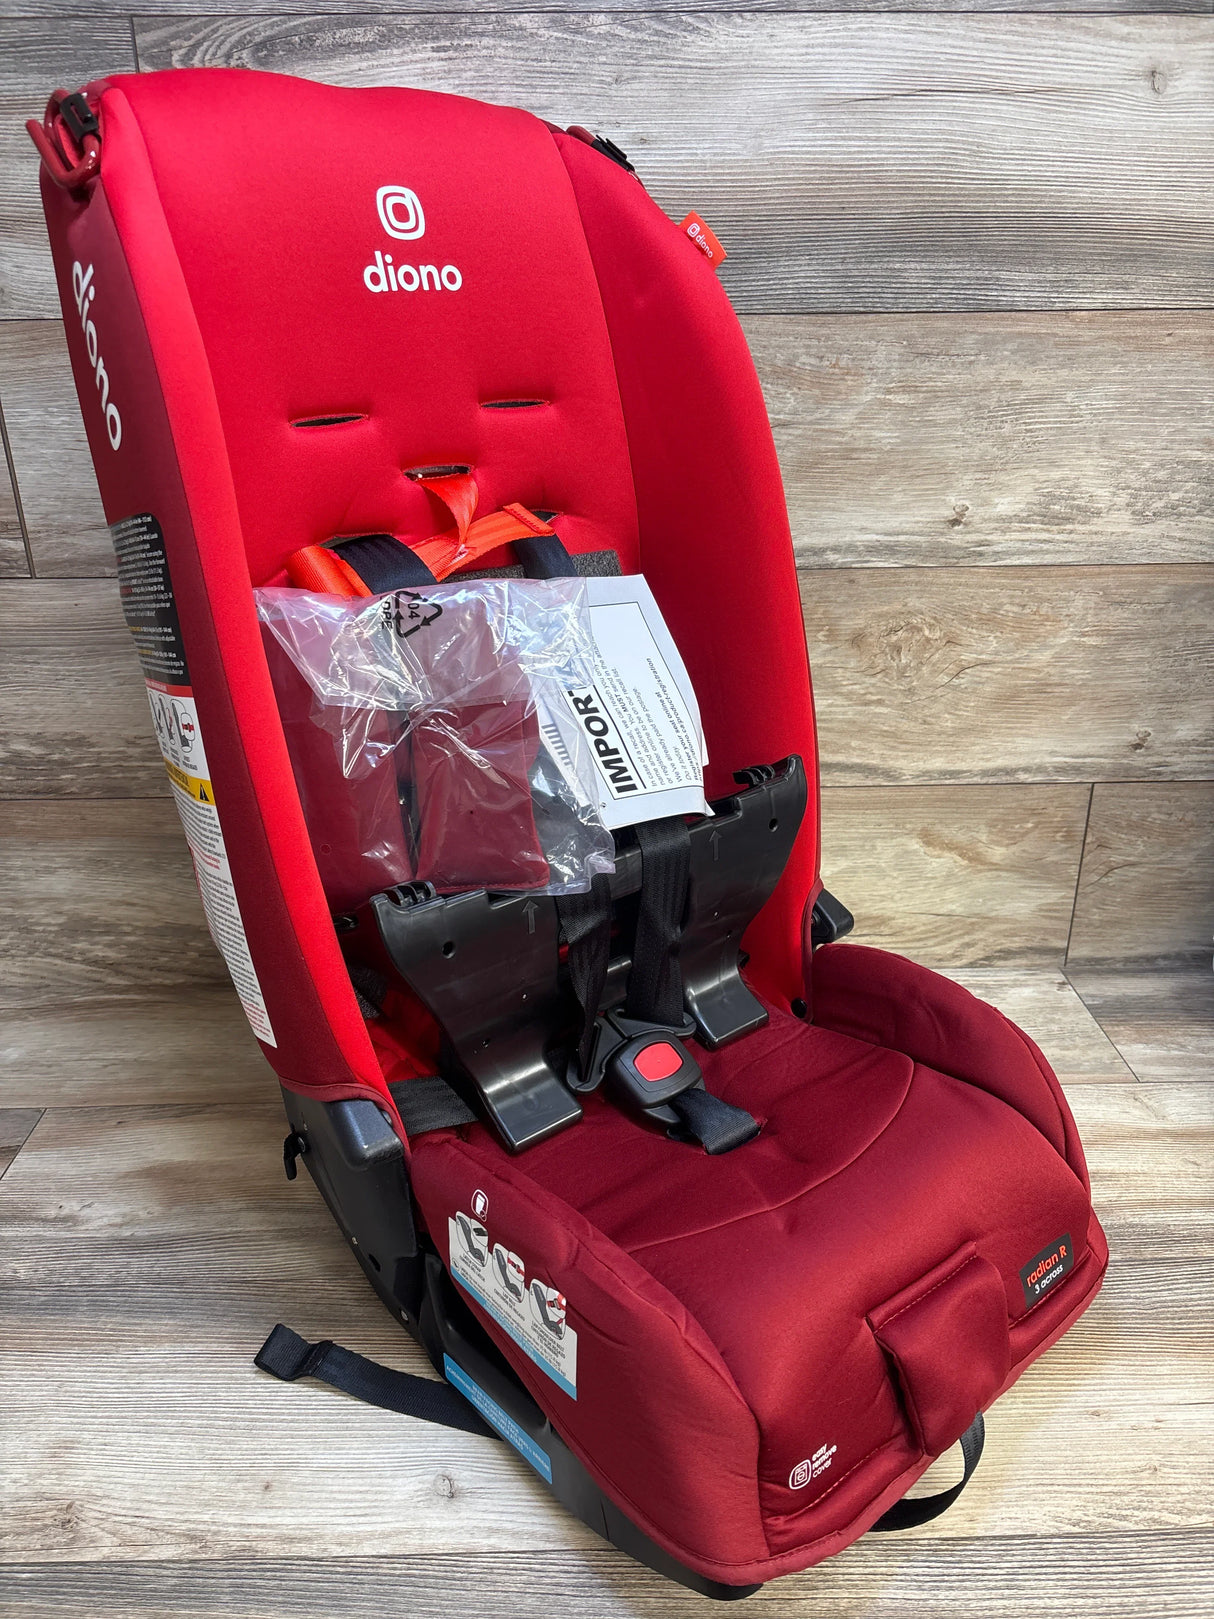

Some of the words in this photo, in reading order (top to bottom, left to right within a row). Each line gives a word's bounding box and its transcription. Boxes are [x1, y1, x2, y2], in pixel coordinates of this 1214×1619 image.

[696, 234, 713, 258] diono
[363, 250, 463, 293] diono
[72, 260, 122, 451] diono
[408, 603, 421, 620] 04
[600, 660, 608, 670] the
[600, 677, 610, 690] you
[606, 677, 618, 692] send
[616, 678, 628, 694] recall
[606, 690, 617, 706] reach
[614, 694, 628, 712] MUST
[616, 707, 624, 718] can
[660, 699, 672, 718] online
[627, 714, 635, 725] You
[669, 720, 680, 733] seat
[568, 687, 638, 793] IMPOR
[678, 734, 688, 750] your
[646, 754, 656, 766] and
[653, 768, 666, 786] name
[1026, 1253, 1059, 1288] radian
[1059, 1245, 1067, 1258] R
[1034, 1284, 1040, 1294] 3
[1040, 1264, 1064, 1288] across
[812, 1443, 828, 1461] easy
[812, 1444, 838, 1470] remove
[812, 1458, 832, 1478] cover
